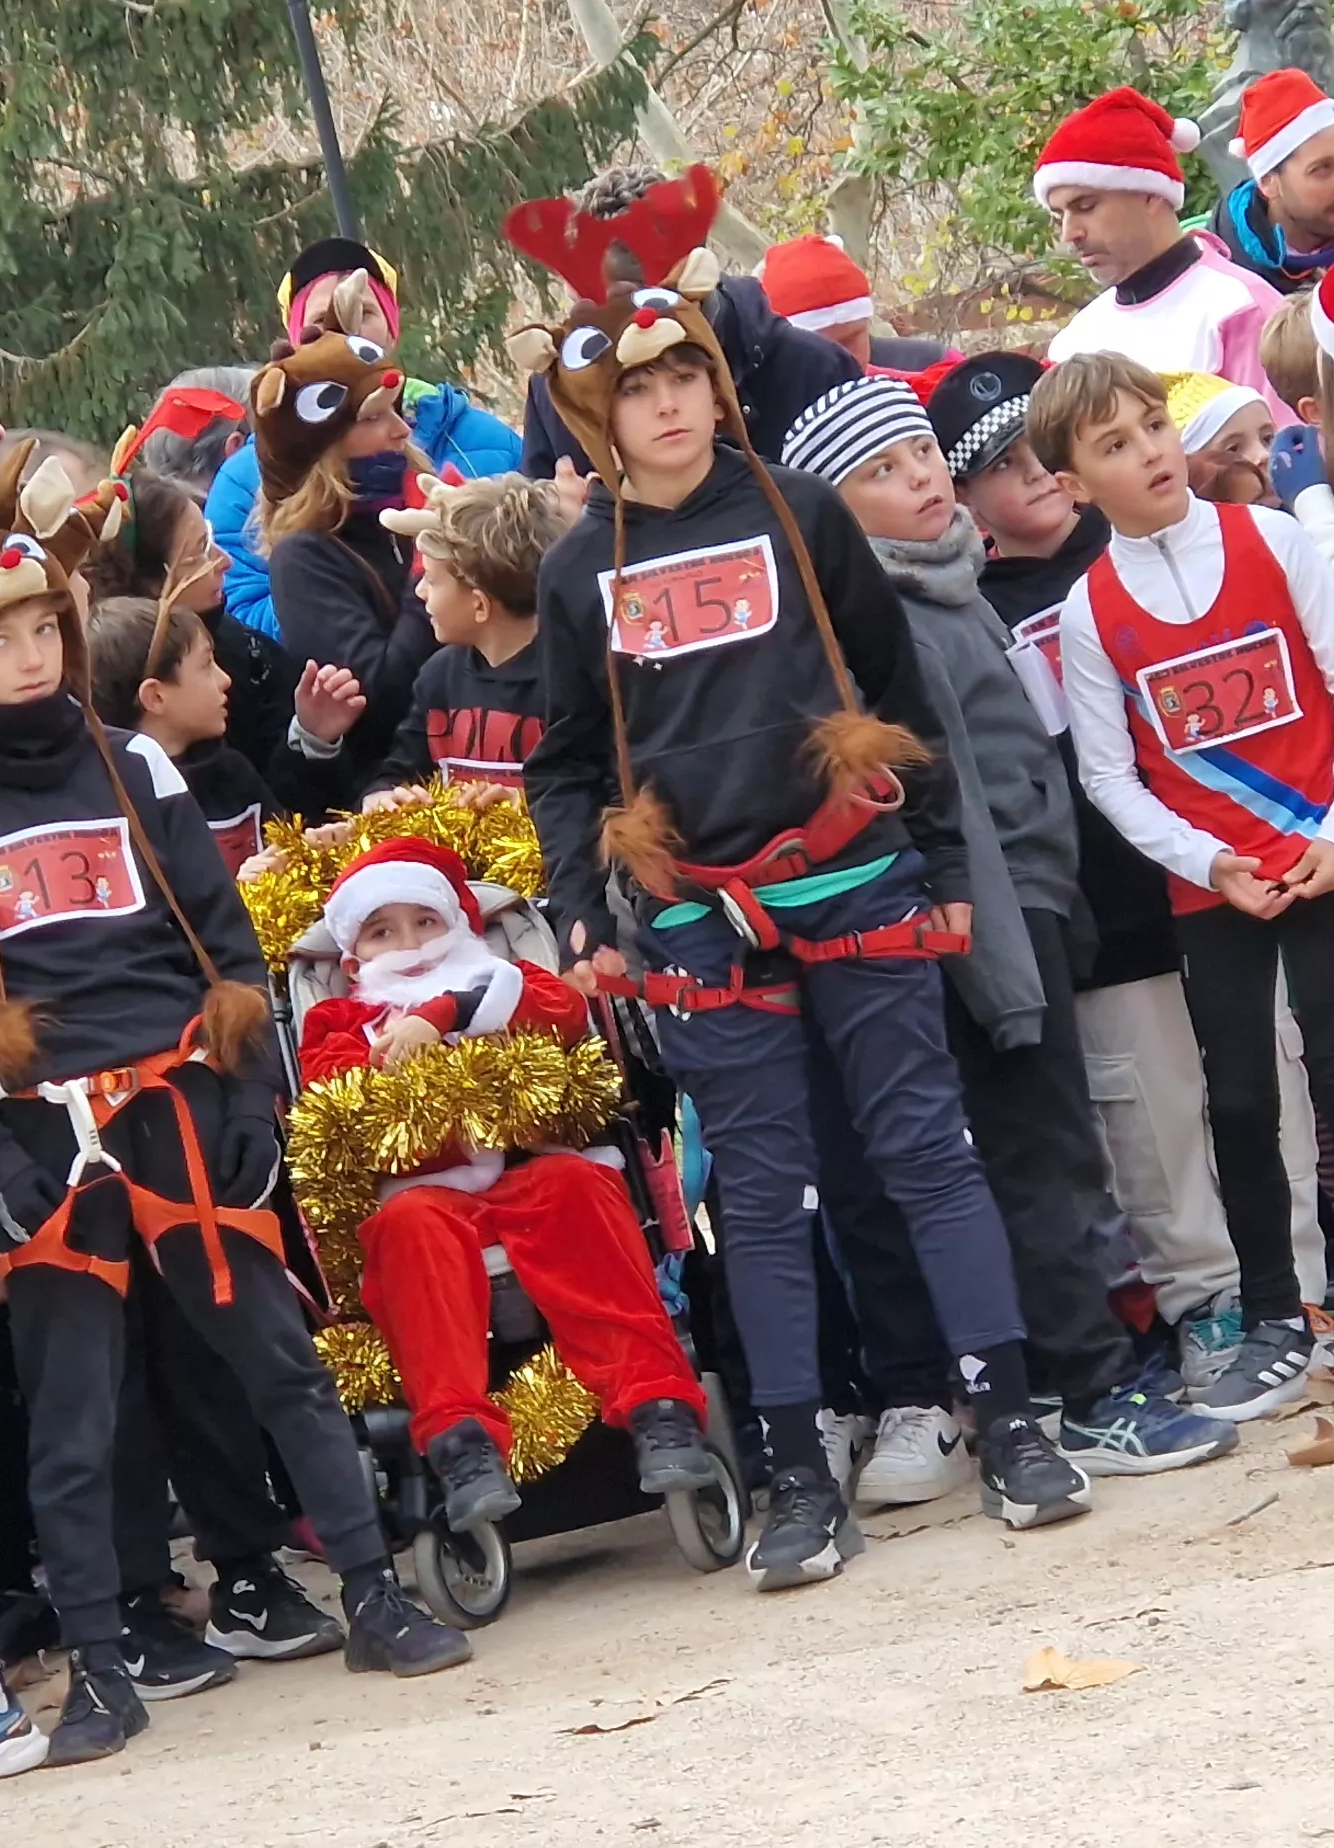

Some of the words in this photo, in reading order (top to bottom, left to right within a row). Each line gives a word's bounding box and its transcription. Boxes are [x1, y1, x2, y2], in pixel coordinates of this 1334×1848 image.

[653, 576, 732, 642] 15
[1182, 668, 1268, 736] 32
[23, 850, 96, 910] 13
